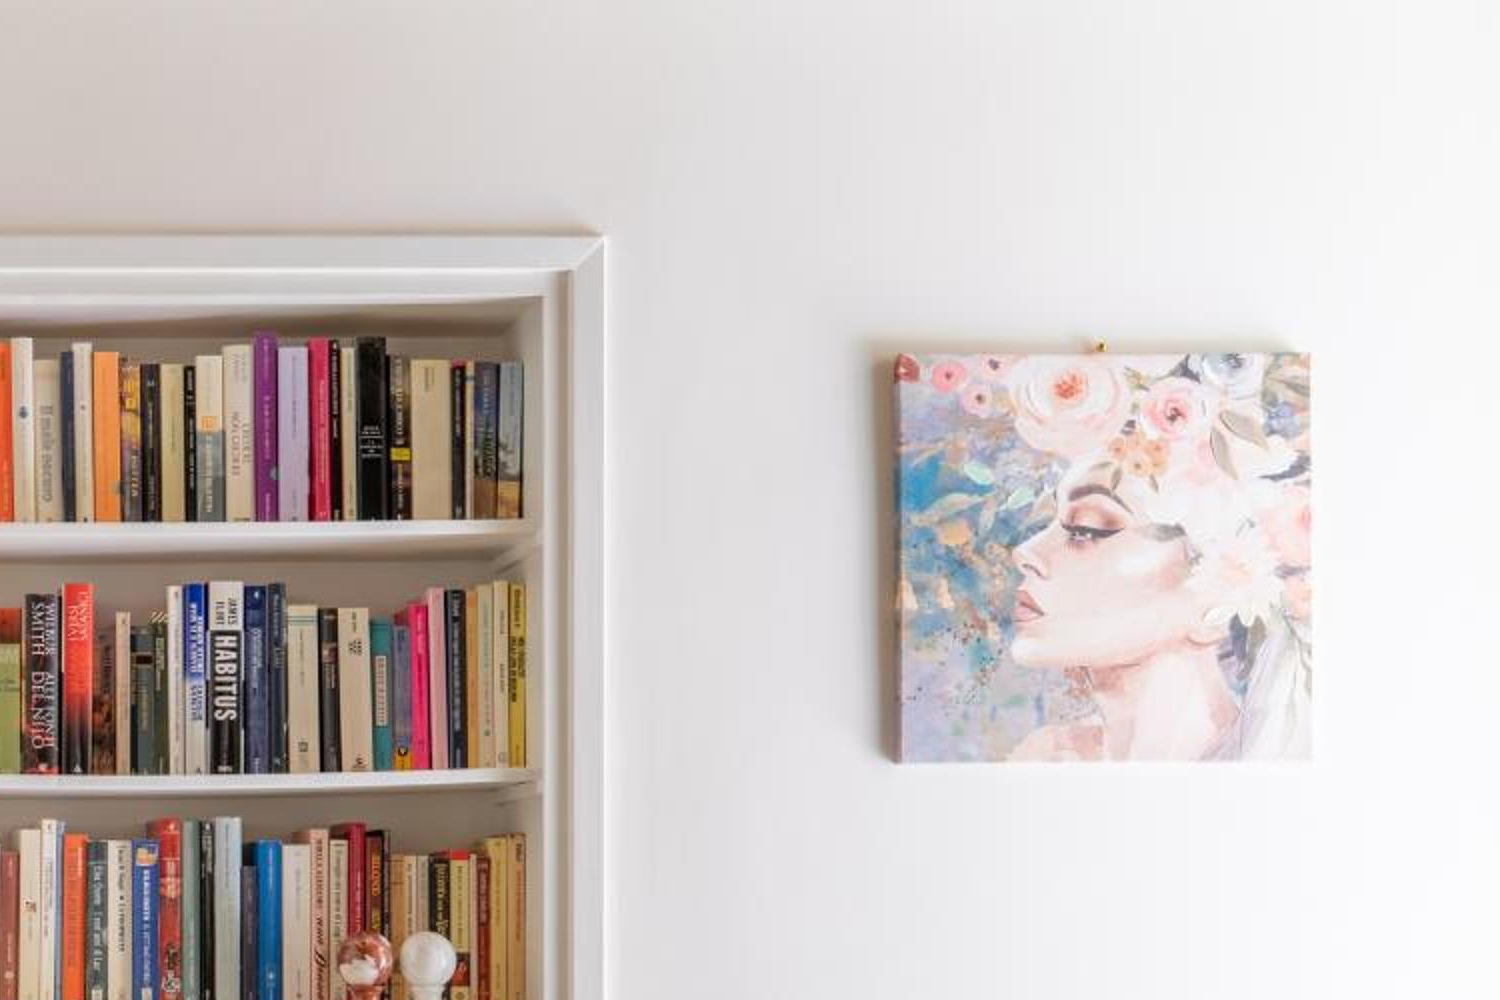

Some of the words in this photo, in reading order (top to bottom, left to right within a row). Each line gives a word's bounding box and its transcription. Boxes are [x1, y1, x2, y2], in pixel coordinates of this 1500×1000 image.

[30, 601, 45, 656] SMITH
[44, 602, 57, 656] WILBUR
[30, 671, 45, 705] DEL
[214, 635, 238, 721] HABITUS
[30, 707, 45, 749] NILO
